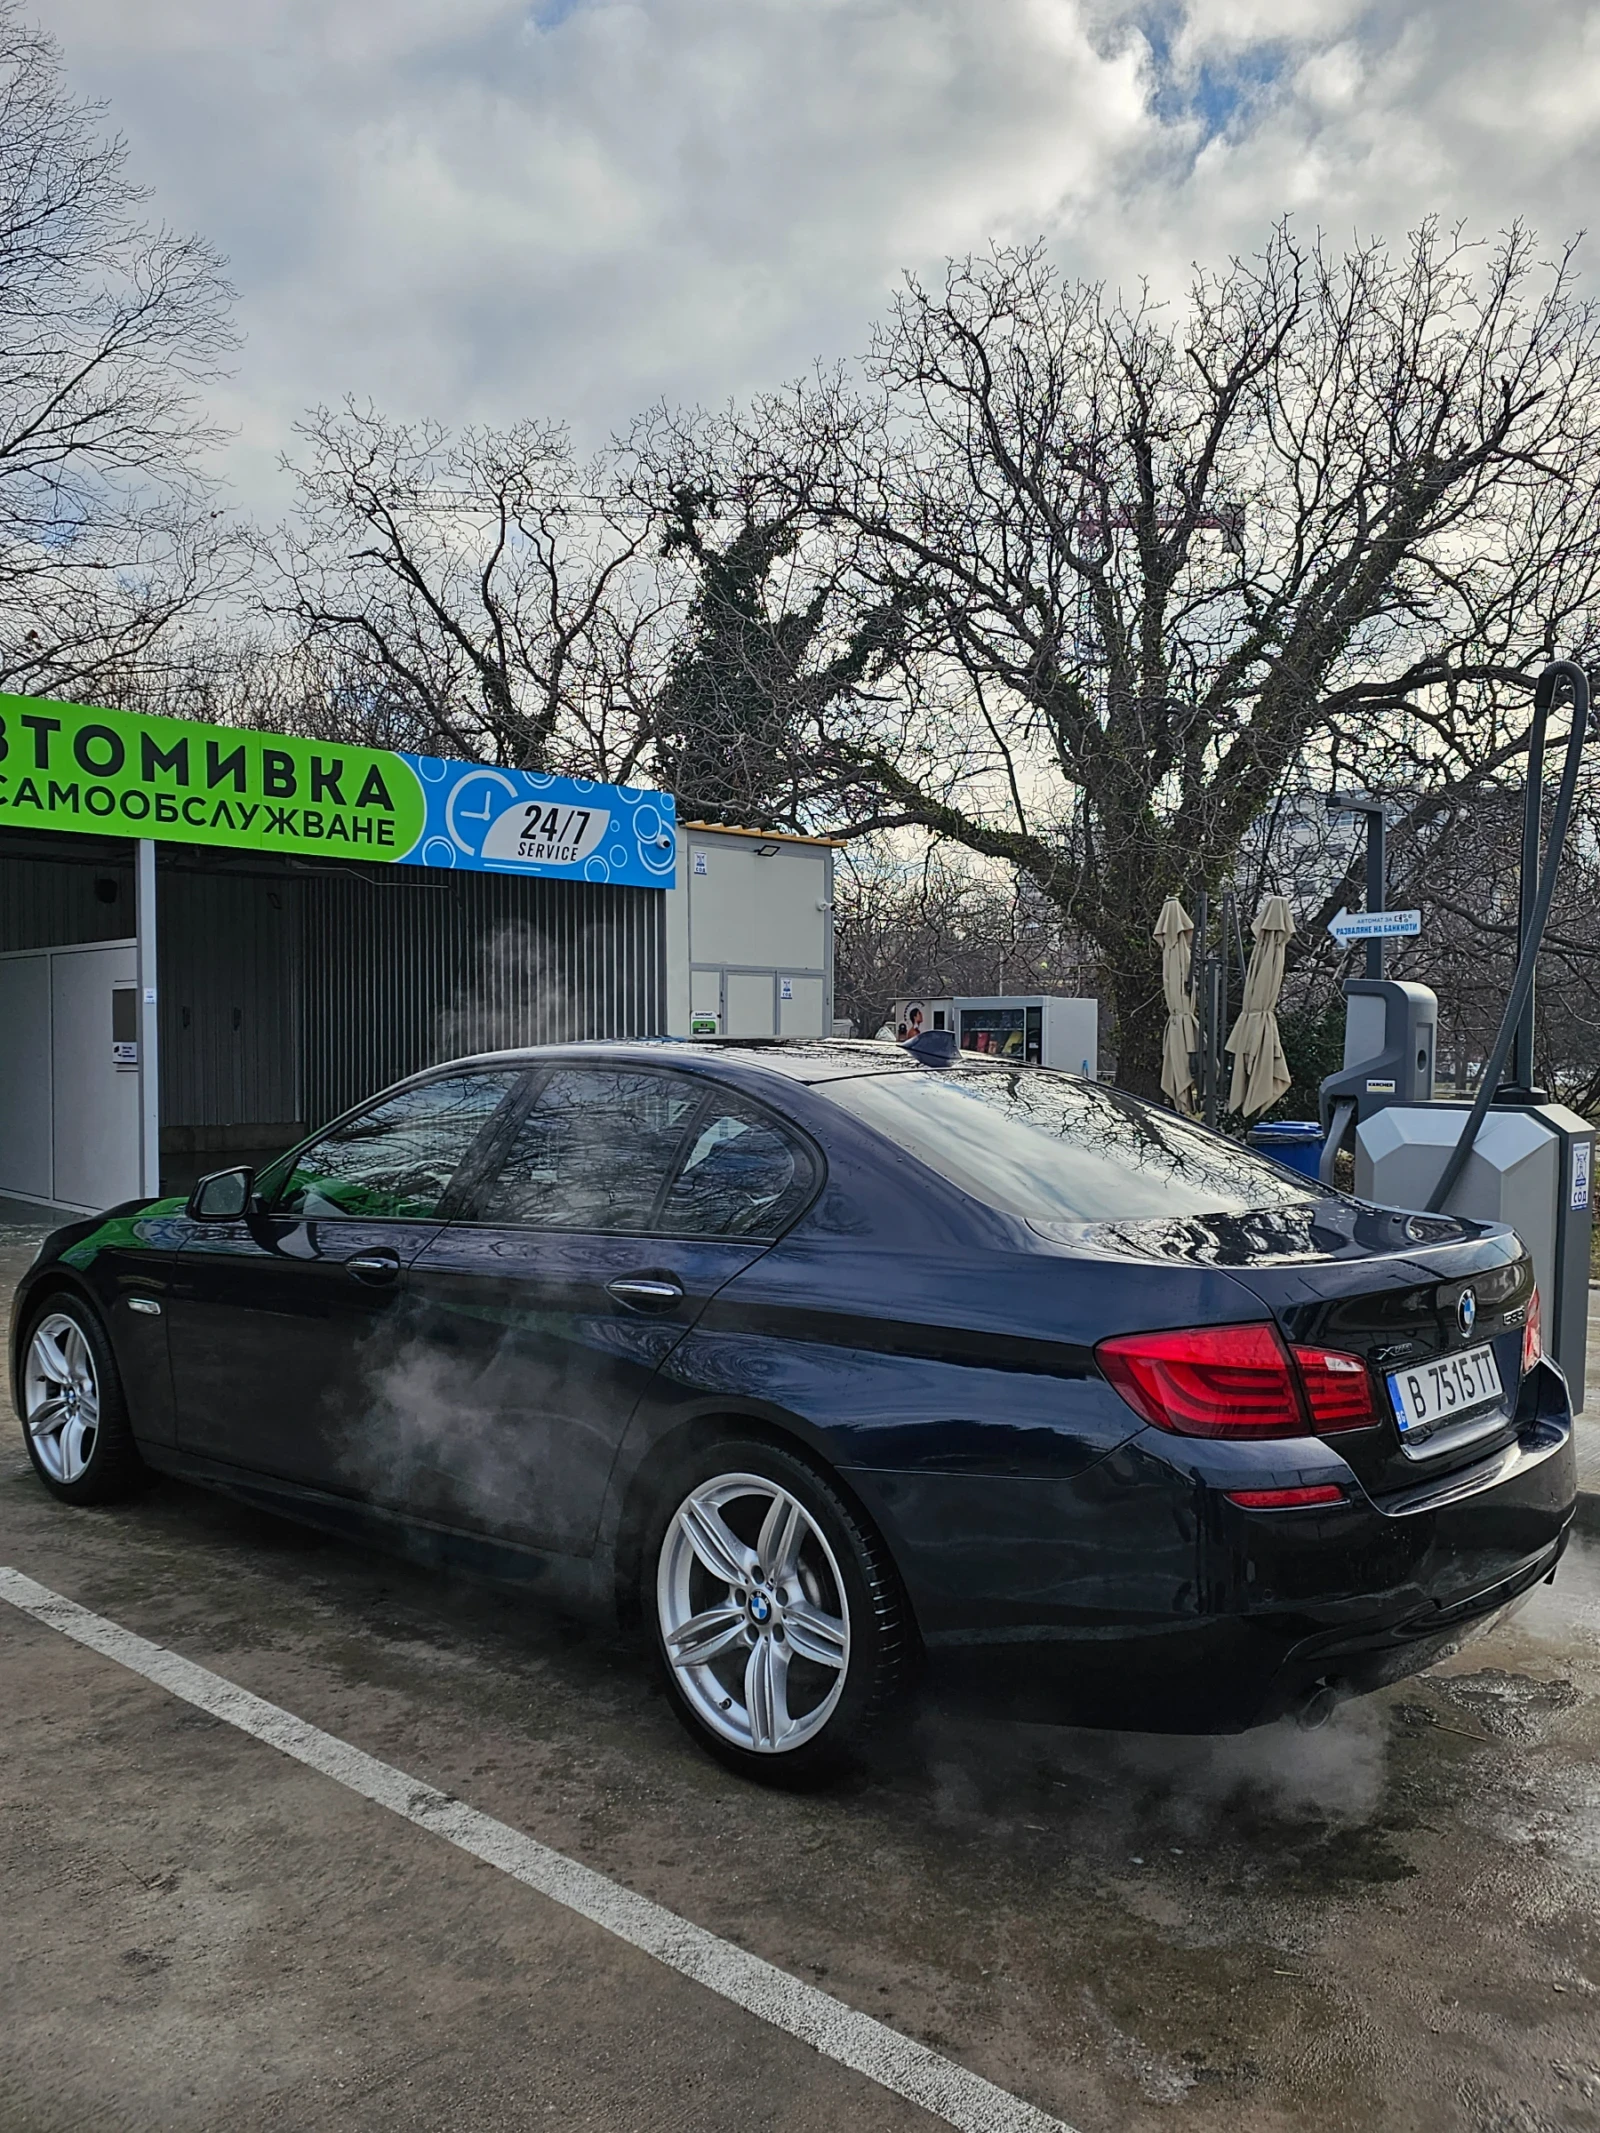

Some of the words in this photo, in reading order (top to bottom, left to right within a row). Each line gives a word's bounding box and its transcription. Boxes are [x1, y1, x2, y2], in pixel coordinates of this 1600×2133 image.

[0, 714, 396, 811] ТОМИВКА
[520, 804, 591, 845] 24/7
[518, 841, 579, 862] SERVICE
[1336, 926, 1372, 935] РАЗВАЛЯНЕ
[1373, 925, 1382, 933] НА
[1383, 922, 1418, 934] БАНКНОТИ
[1573, 1190, 1587, 1204] СОД
[1407, 1375, 1427, 1419] B
